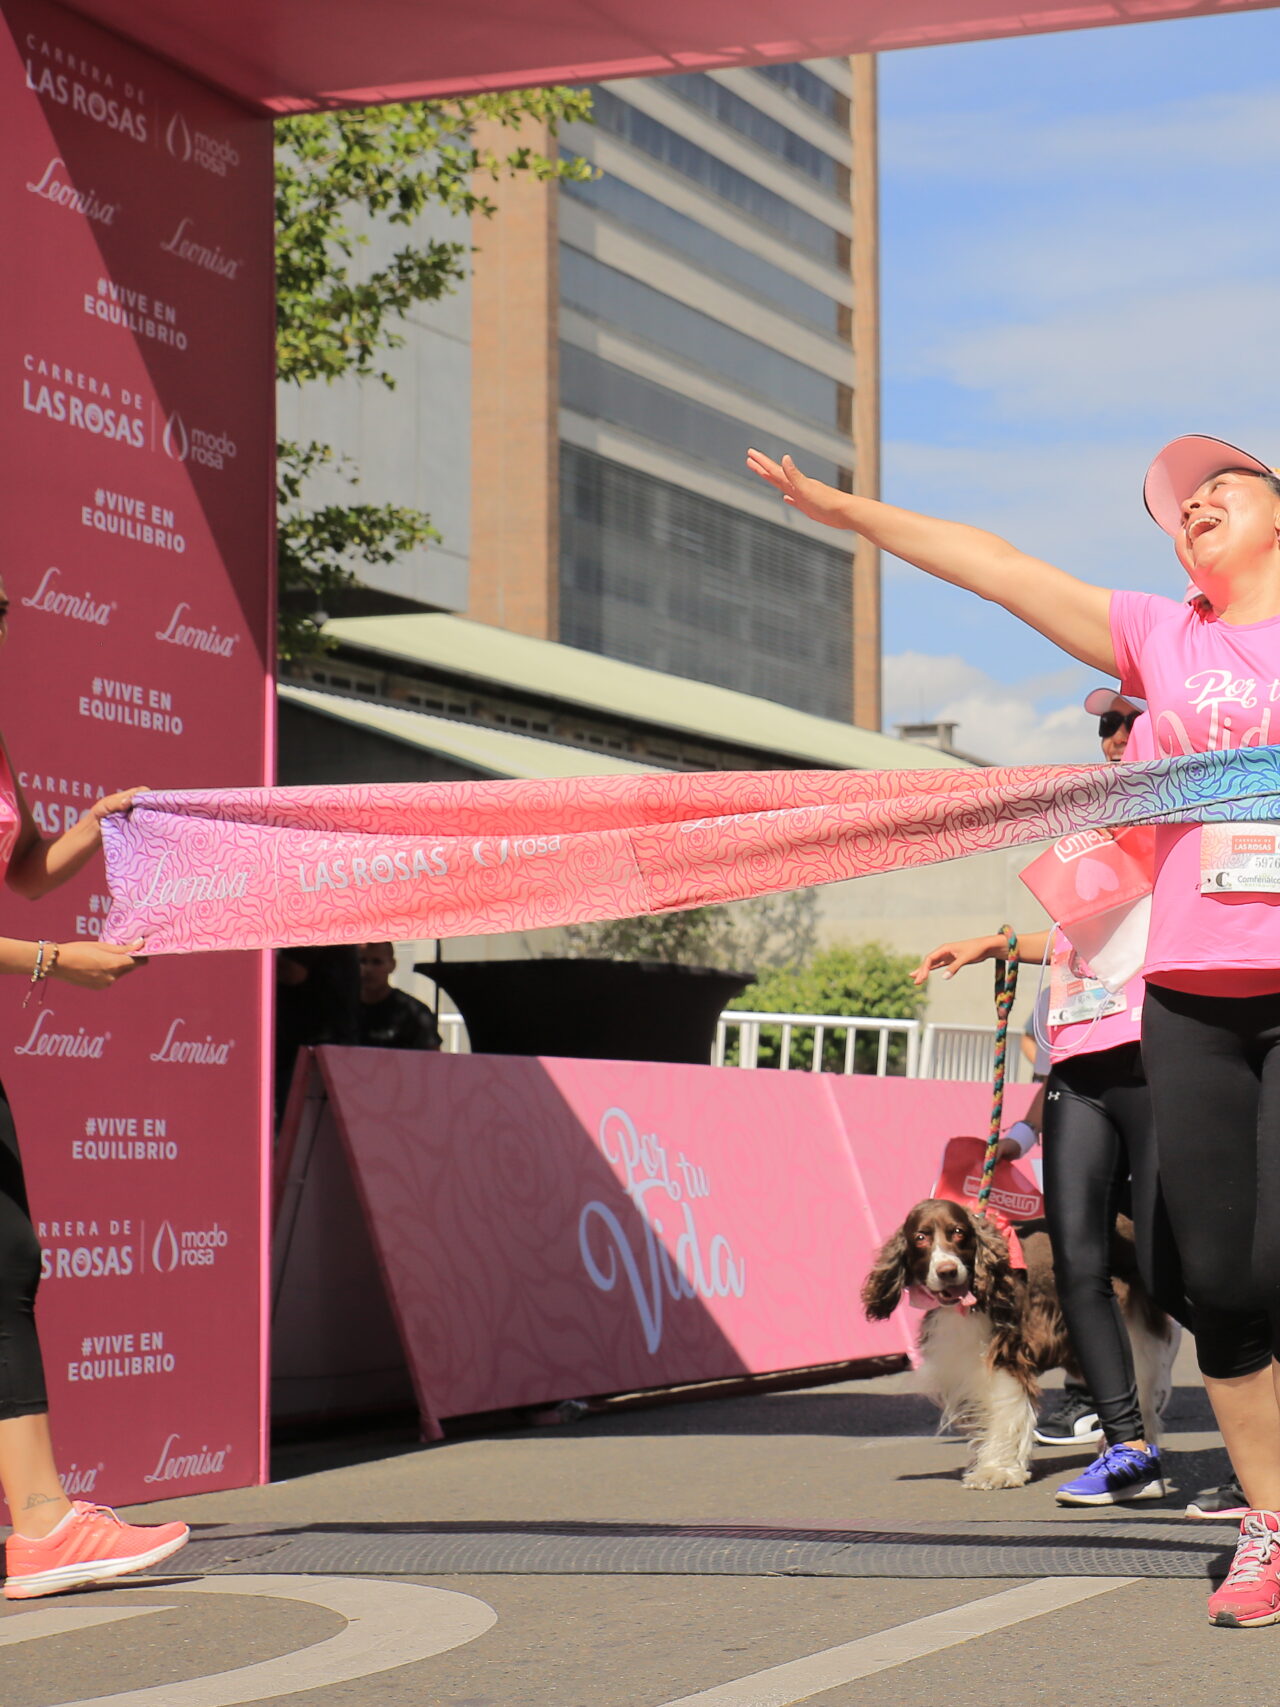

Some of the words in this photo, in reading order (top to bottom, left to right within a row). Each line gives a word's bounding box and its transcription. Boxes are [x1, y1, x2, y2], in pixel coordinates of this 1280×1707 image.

[26, 33, 114, 89] CARRERA
[124, 80, 145, 105] DE
[194, 131, 239, 168] modo
[194, 149, 228, 177] rosa
[26, 157, 116, 227] Leonisa
[160, 217, 238, 281] Leonisa
[97, 277, 148, 314] #VIVE
[154, 299, 177, 325] EN
[84, 293, 188, 351] EQUILIBRIO
[24, 353, 111, 400] CARRERA
[121, 388, 142, 410] DE
[191, 426, 237, 459] modo
[191, 445, 224, 471] rosa
[95, 487, 145, 520] #VIVE
[151, 505, 174, 529] EN
[81, 505, 186, 554] EQUILIBRIO
[21, 566, 111, 626] Leonisa
[155, 602, 235, 657] Leonisa
[92, 676, 143, 705] #VIVE
[149, 689, 172, 712] EN
[1184, 669, 1258, 709] Por
[78, 697, 183, 736] EQUILIBRIO
[18, 771, 106, 800] CARRERA
[32, 801, 61, 833] AS
[513, 835, 561, 857] rosa
[1255, 857, 1280, 869] 5976
[133, 849, 251, 909] Leonisa
[14, 1009, 106, 1059] Leonisa
[150, 1018, 229, 1065] Leonisa
[85, 1117, 138, 1137] #VIVE
[143, 1118, 166, 1137] EN
[72, 1140, 178, 1161] EQUILIBRIO
[599, 1107, 682, 1201] Por
[676, 1151, 710, 1198] tu
[38, 1220, 99, 1238] RRERA
[110, 1220, 132, 1236] DE
[181, 1223, 228, 1248] modo
[56, 1246, 133, 1279] ROSAS
[181, 1247, 214, 1266] rosa
[578, 1178, 745, 1355] Vida
[81, 1333, 135, 1357] #VIVE
[140, 1331, 163, 1350] EN
[67, 1353, 175, 1383] EQUILIBRIO
[144, 1433, 227, 1484] Leonisa
